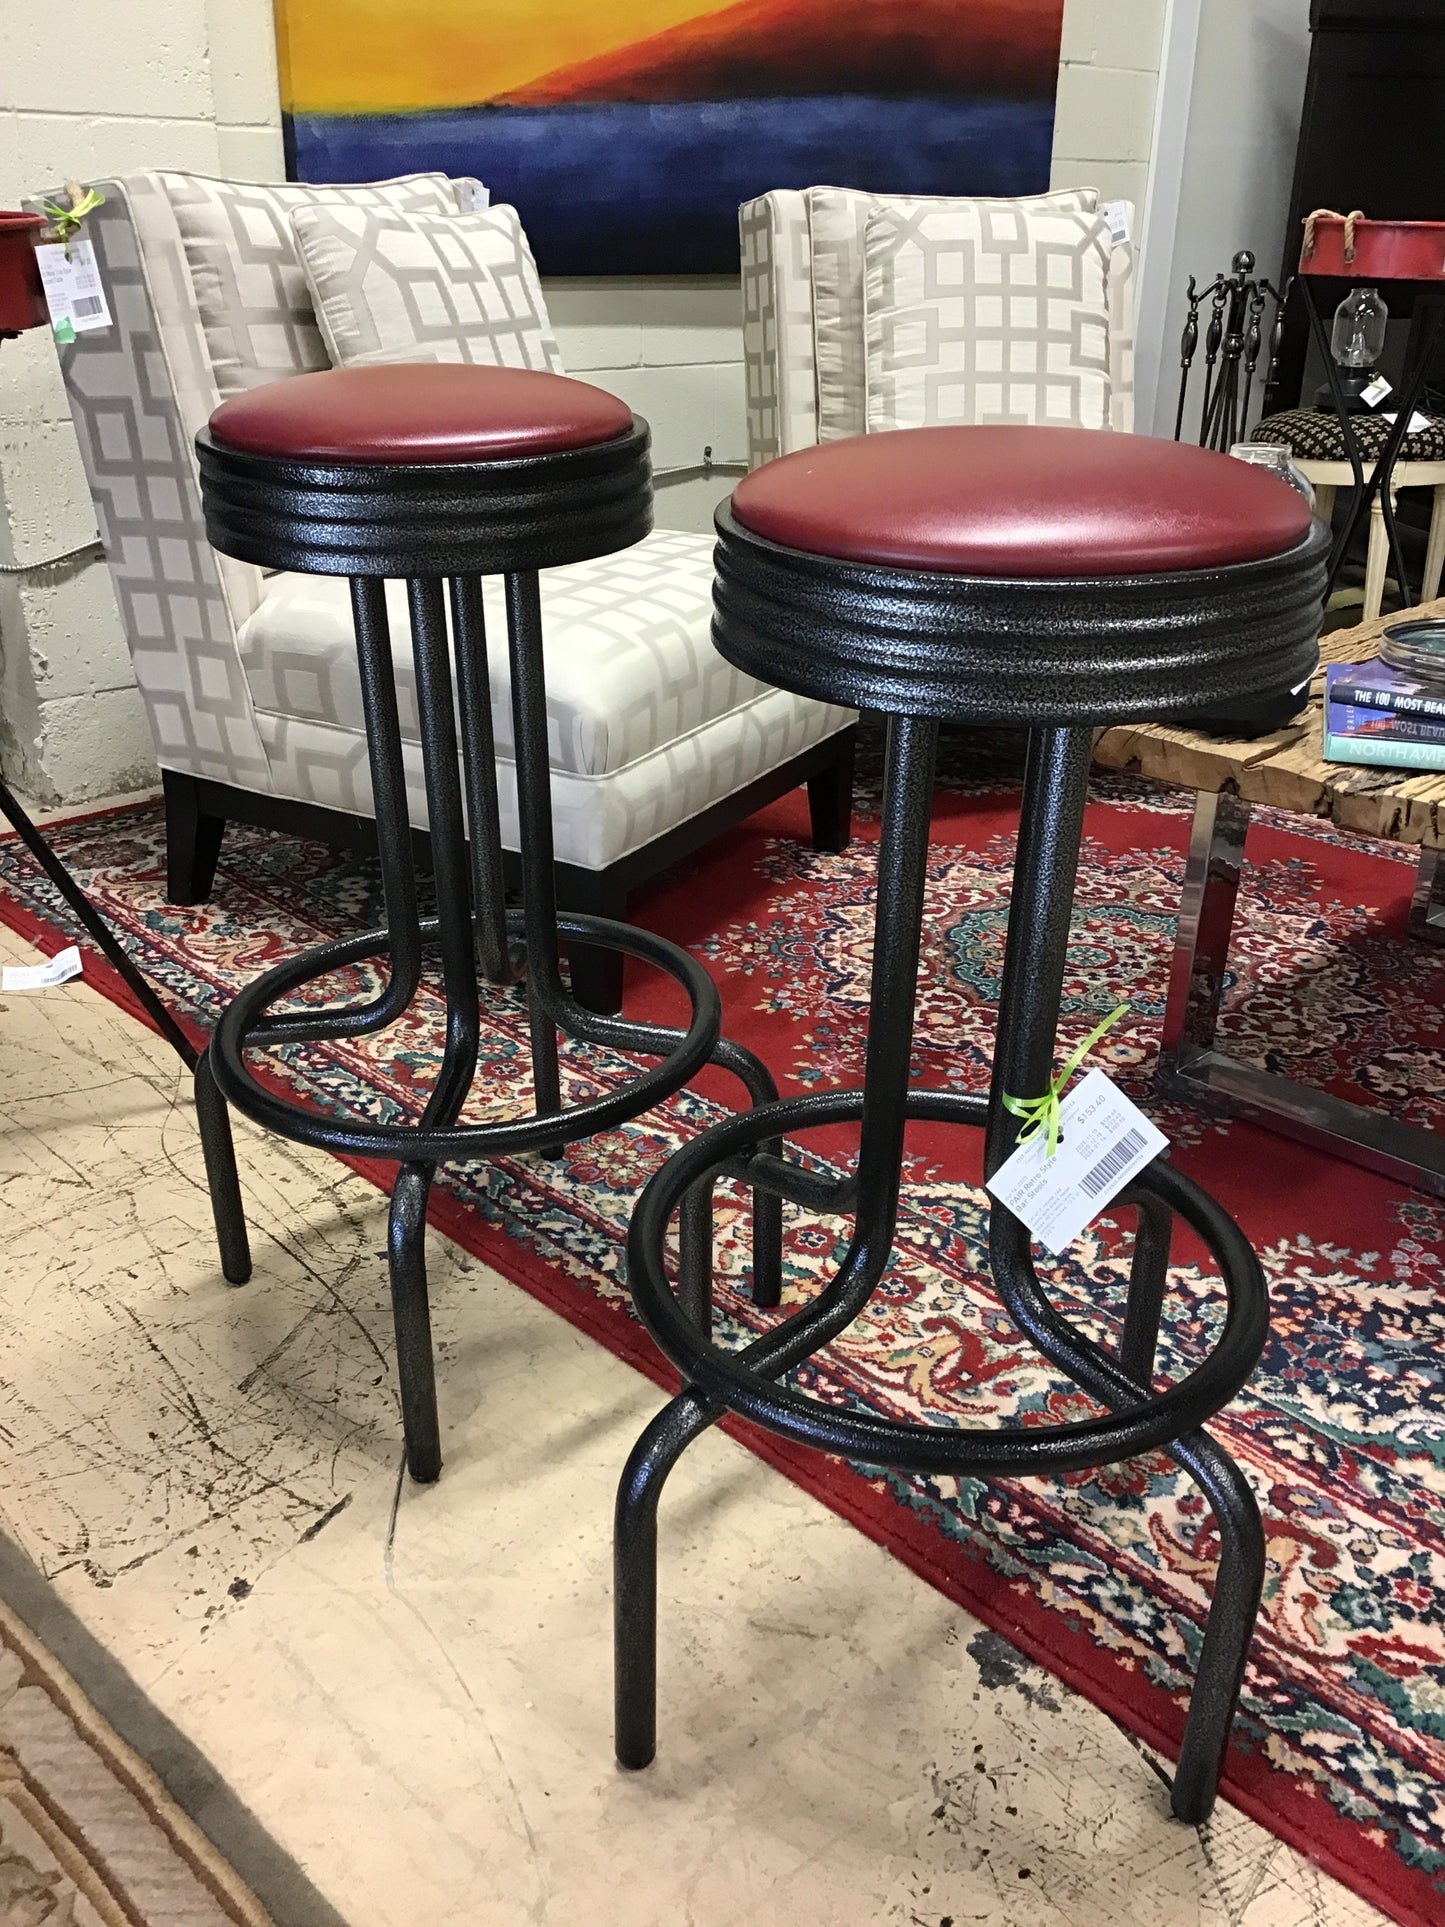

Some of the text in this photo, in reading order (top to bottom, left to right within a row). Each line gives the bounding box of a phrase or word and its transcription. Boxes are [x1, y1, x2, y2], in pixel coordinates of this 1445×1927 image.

[1354, 690, 1372, 703] THE
[1375, 692, 1390, 706] 100
[1394, 696, 1423, 711] MOST
[1350, 742, 1407, 759] NORTH
[1077, 1094, 1106, 1125] $153.40
[1009, 1189, 1026, 1207] PAIR
[1023, 1172, 1042, 1191] Retro
[1039, 1156, 1058, 1174] Style
[1015, 1198, 1029, 1213] Bar
[1026, 1179, 1048, 1200] Stools
